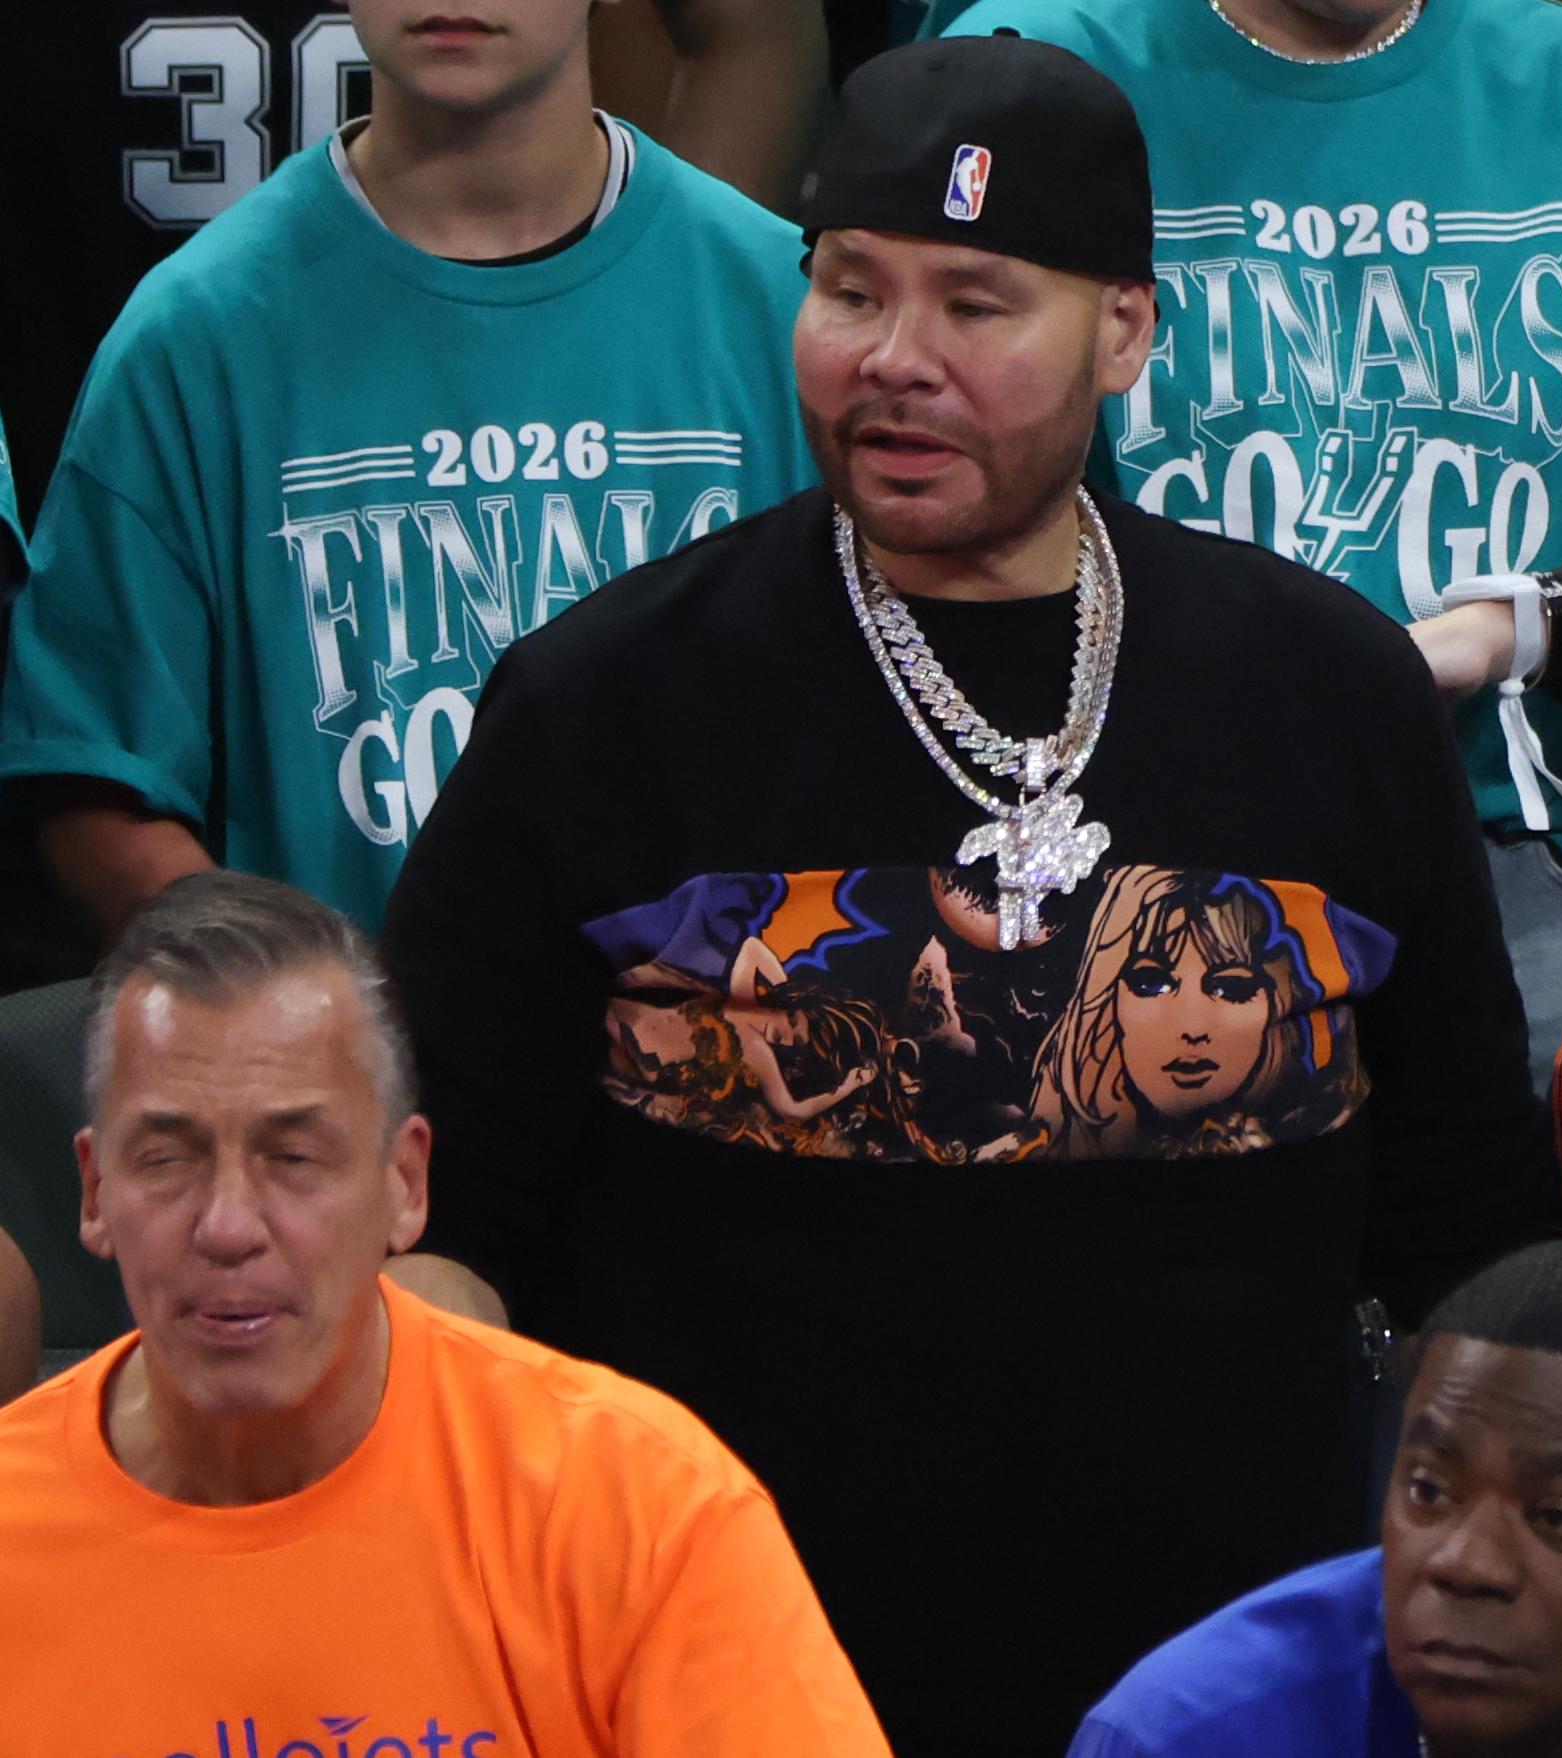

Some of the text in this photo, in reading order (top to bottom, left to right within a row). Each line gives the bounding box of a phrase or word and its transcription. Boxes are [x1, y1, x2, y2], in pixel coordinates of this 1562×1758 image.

[1251, 199, 1430, 259] 2026
[422, 421, 609, 486] 2026
[290, 489, 740, 722] FINA
